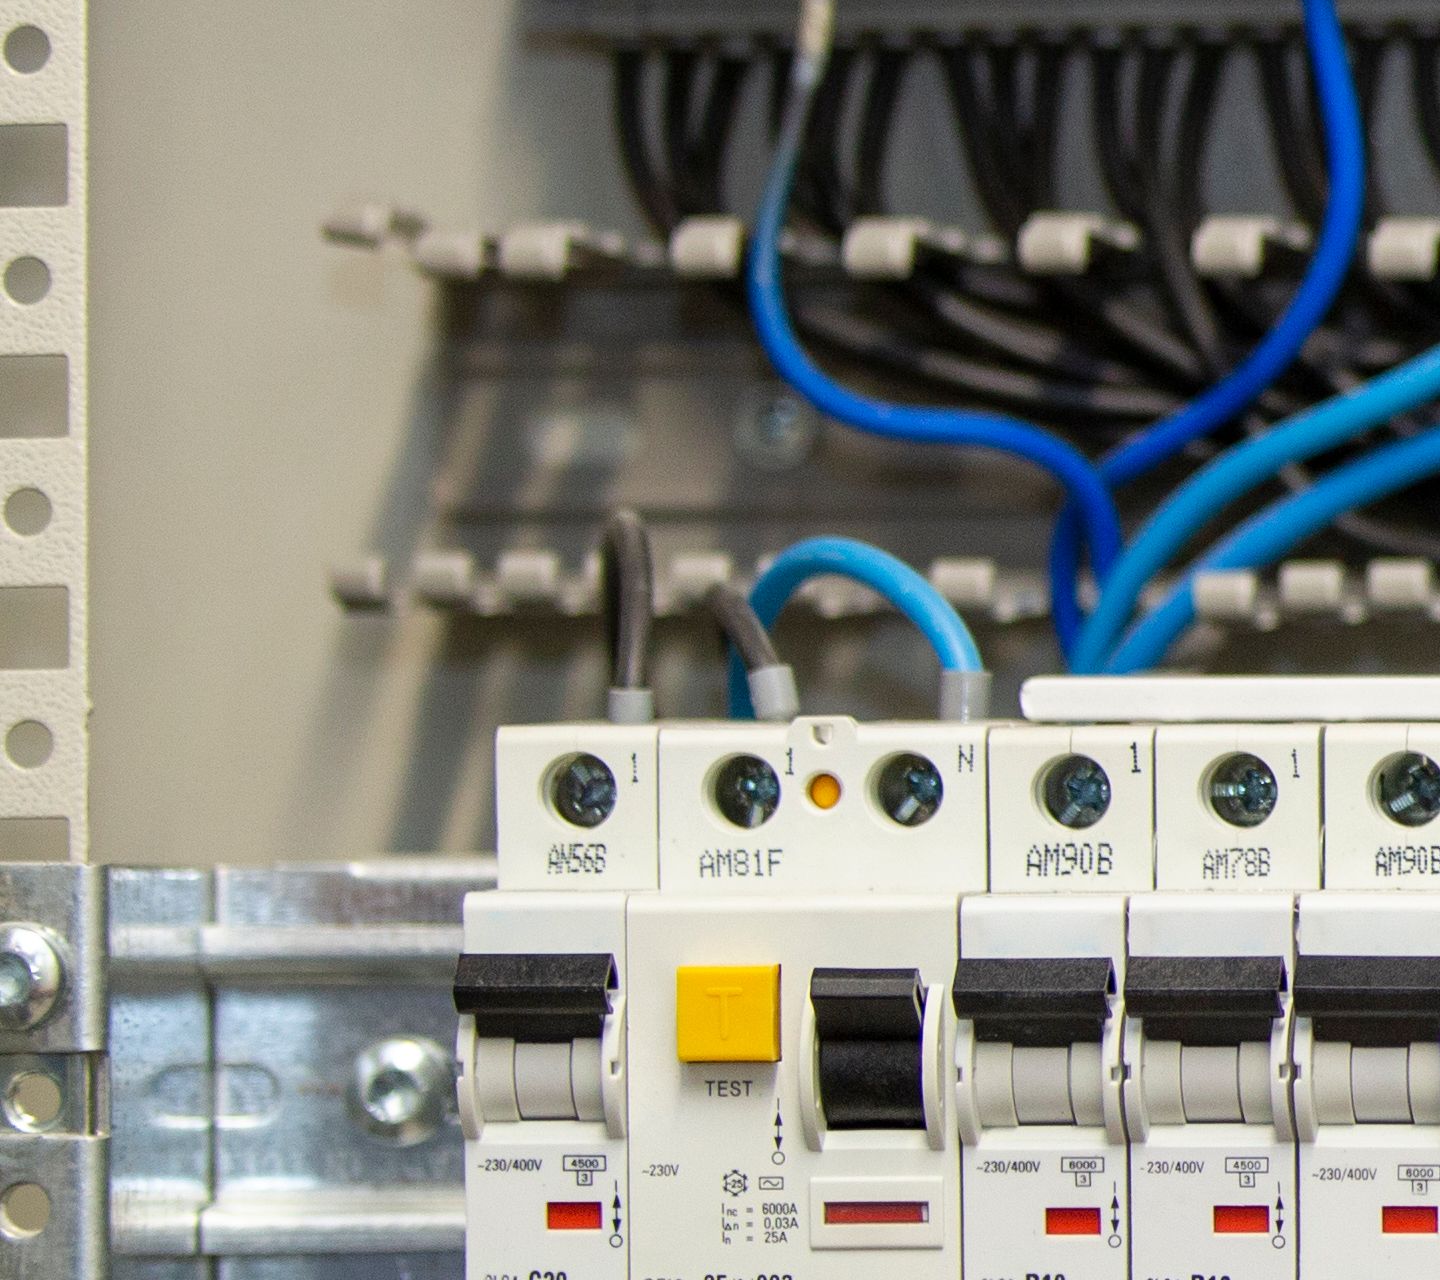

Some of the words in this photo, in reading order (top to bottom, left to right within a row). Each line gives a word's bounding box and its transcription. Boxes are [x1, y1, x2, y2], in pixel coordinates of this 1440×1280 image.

[631, 753, 638, 783] 1
[785, 748, 794, 775] 1
[958, 744, 974, 772] N
[1130, 742, 1141, 773] 1
[1291, 749, 1300, 778] 1
[700, 849, 783, 877] AM81F
[1027, 843, 1112, 876] AM90B
[1203, 847, 1270, 879] AM78B
[708, 989, 739, 1040] T
[705, 1080, 753, 1097] TEST
[568, 1158, 600, 1168] 4500
[1067, 1159, 1099, 1169] 6000
[1231, 1160, 1263, 1171] 4500
[762, 1203, 797, 1215] 6000A
[765, 1231, 787, 1243] 25A
